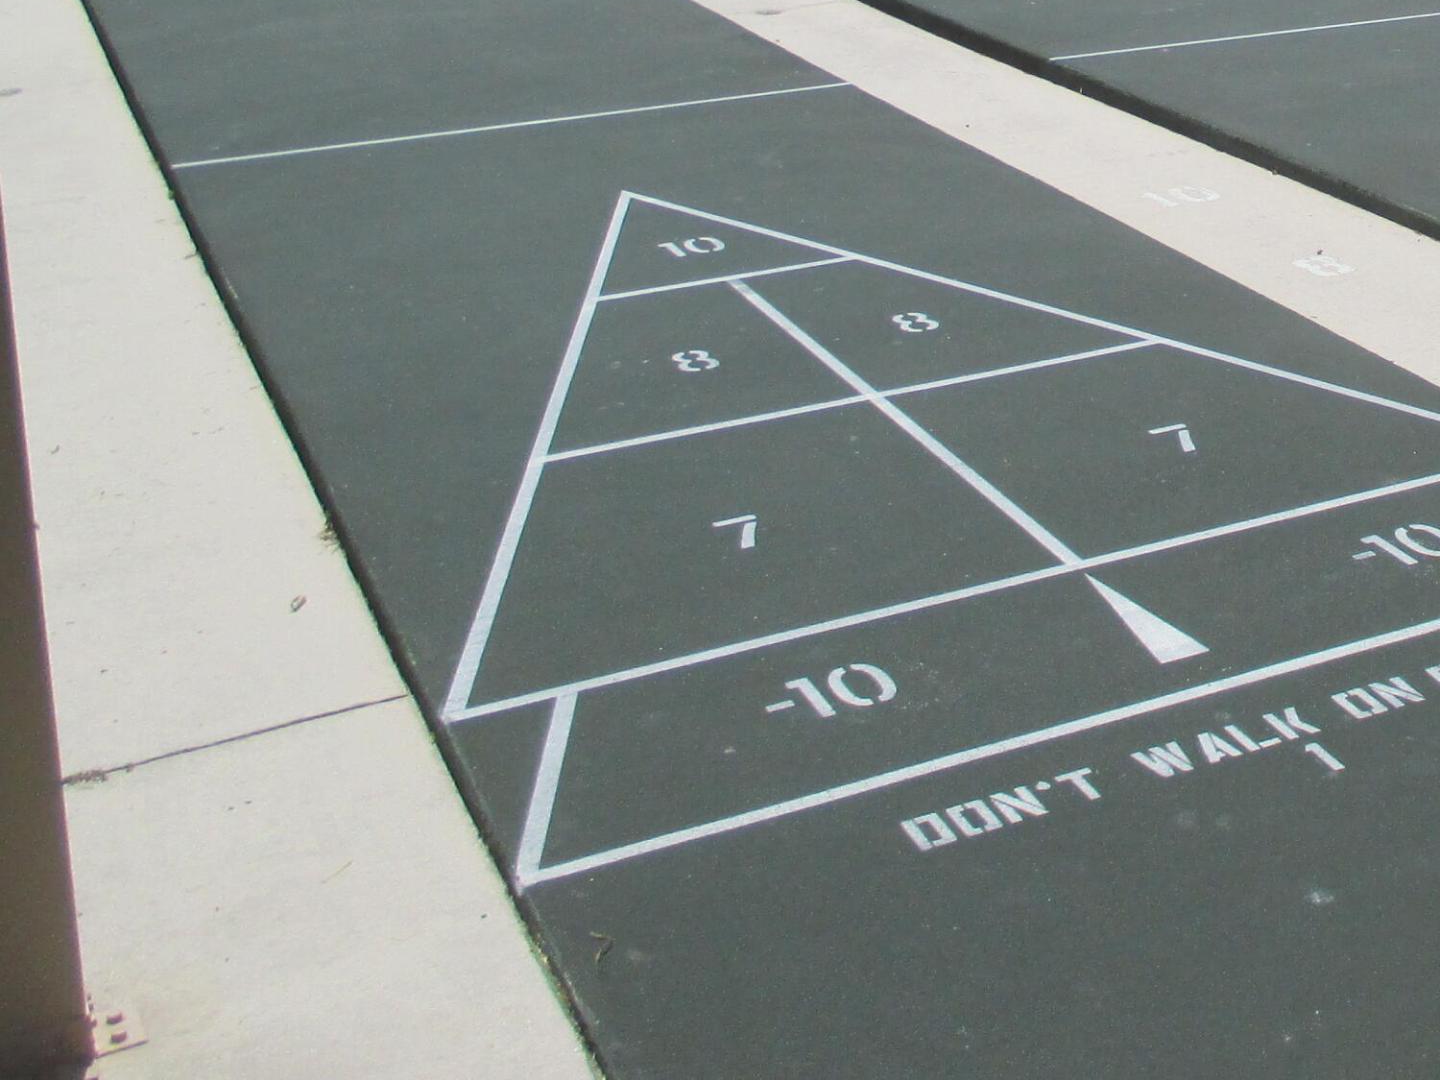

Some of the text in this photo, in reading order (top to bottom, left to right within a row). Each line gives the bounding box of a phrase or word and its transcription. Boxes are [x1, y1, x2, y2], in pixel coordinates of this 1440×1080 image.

[1141, 185, 1221, 208] 10
[657, 235, 726, 259] 10
[891, 312, 940, 333] 8
[671, 349, 720, 372] 8
[1147, 423, 1196, 453] 7
[712, 514, 757, 549] 7
[764, 662, 898, 718] -10
[899, 767, 1102, 851] DON'T
[1130, 706, 1321, 778] WALK
[1331, 676, 1425, 720] ON
[1304, 742, 1346, 772] 1
